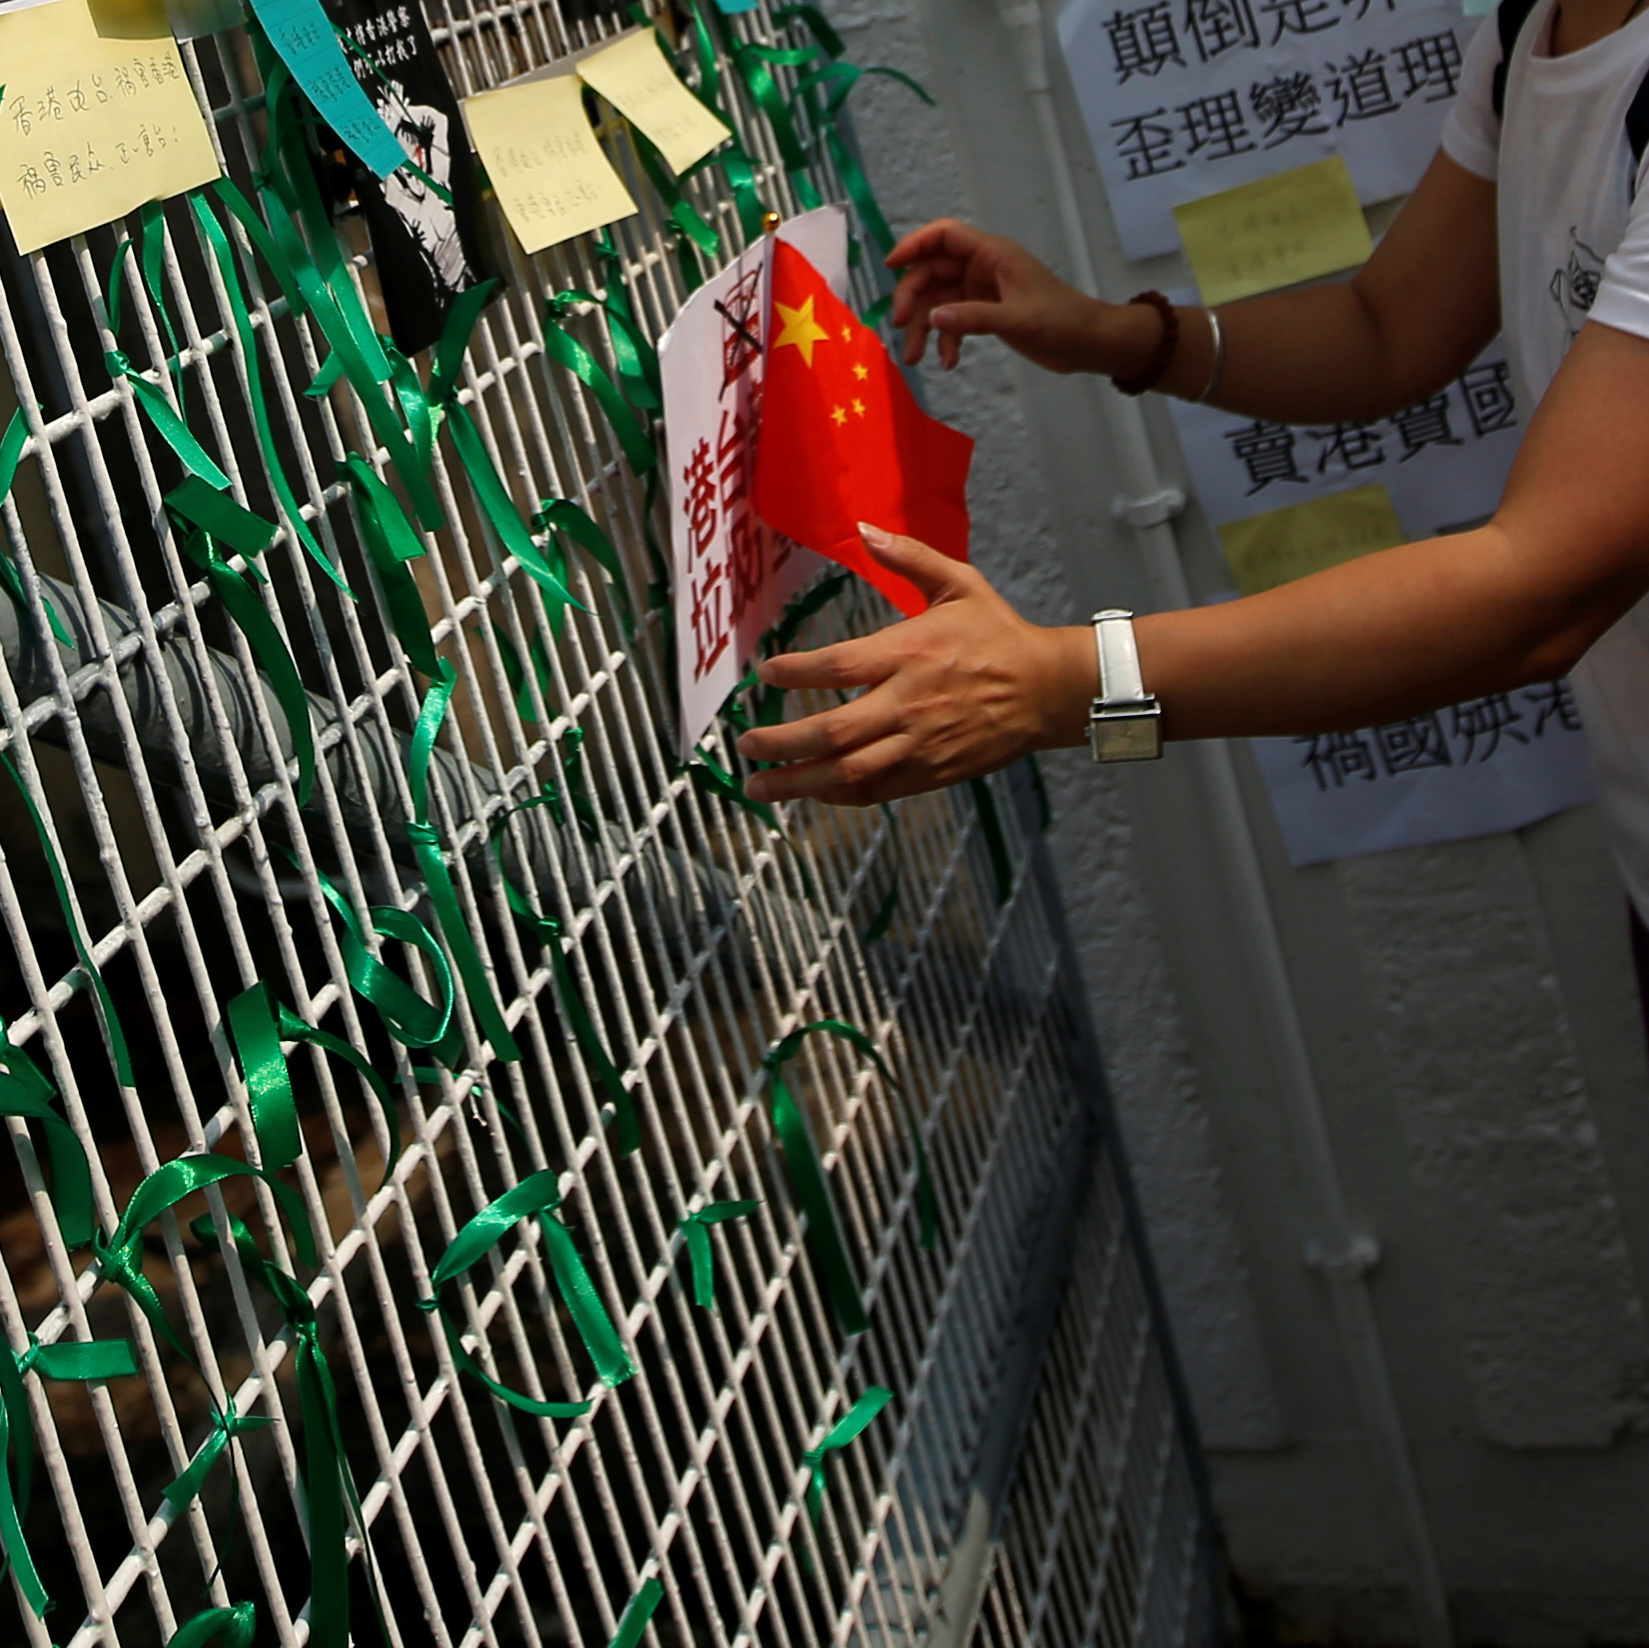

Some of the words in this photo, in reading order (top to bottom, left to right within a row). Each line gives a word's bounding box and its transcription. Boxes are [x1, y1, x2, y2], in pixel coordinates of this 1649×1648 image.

[1110, 28, 1462, 181] 歪理變道理
[683, 402, 750, 574] 港台
